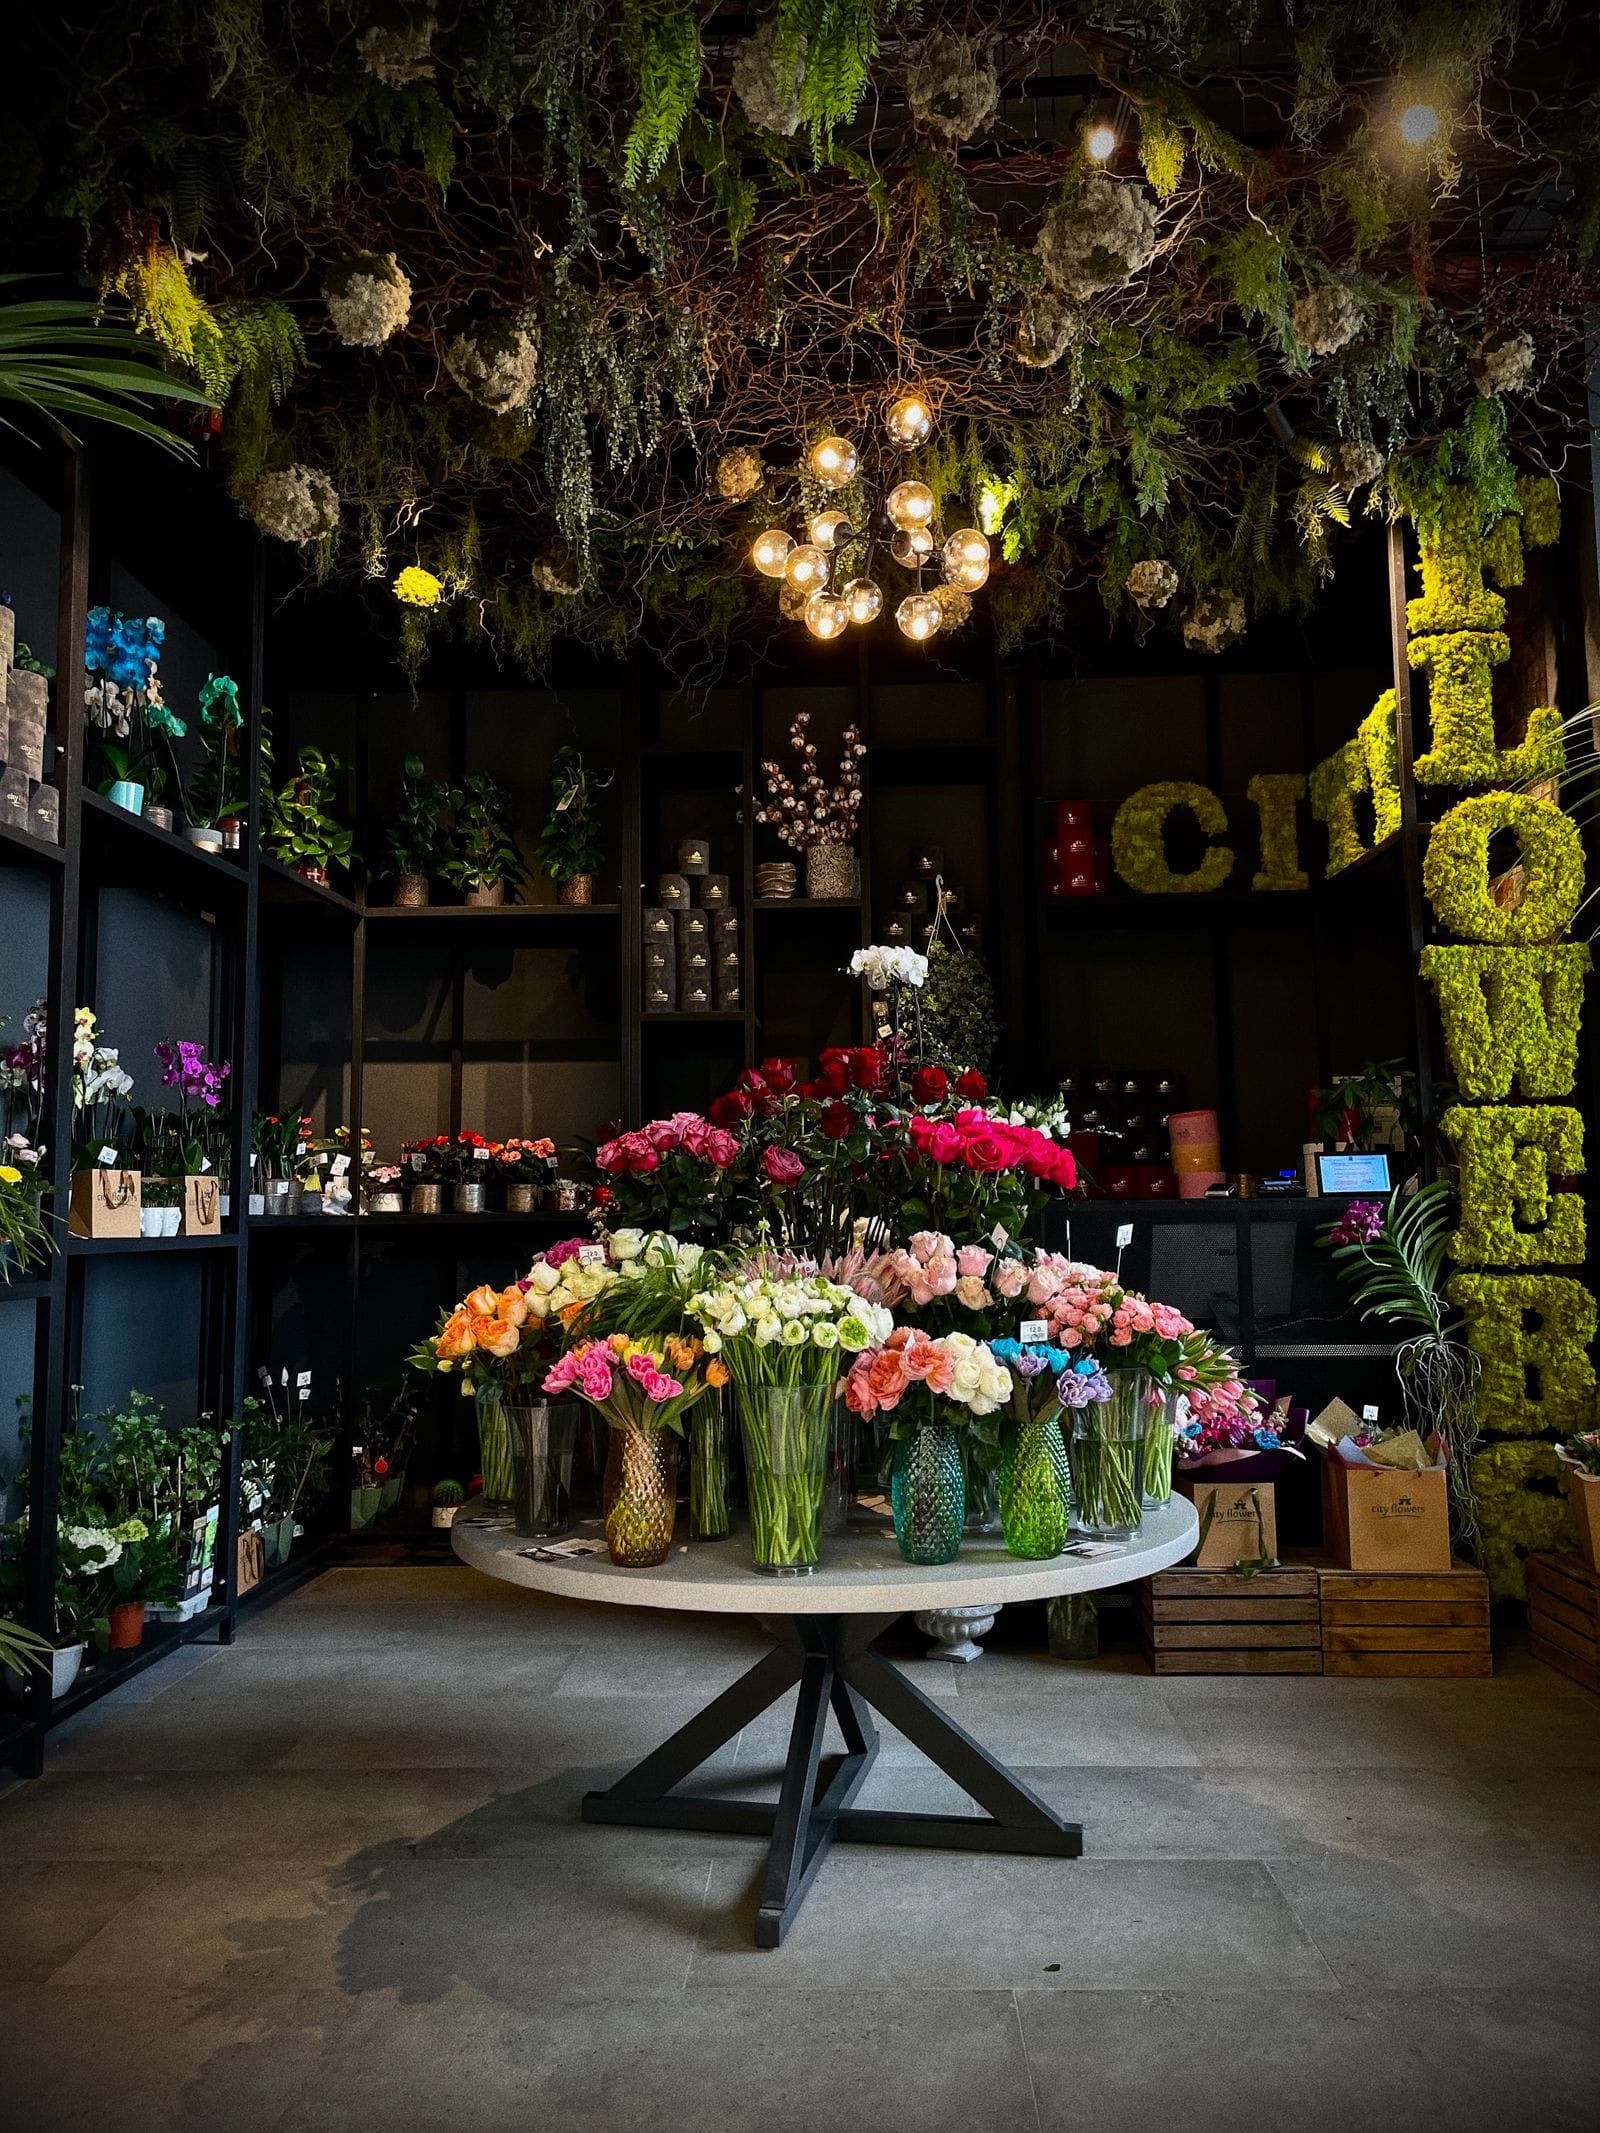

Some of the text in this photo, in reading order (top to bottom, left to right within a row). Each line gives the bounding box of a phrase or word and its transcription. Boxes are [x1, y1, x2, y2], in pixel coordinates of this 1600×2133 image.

[1227, 1508, 1257, 1519] flower
[1371, 1503, 1425, 1515] city flowers
